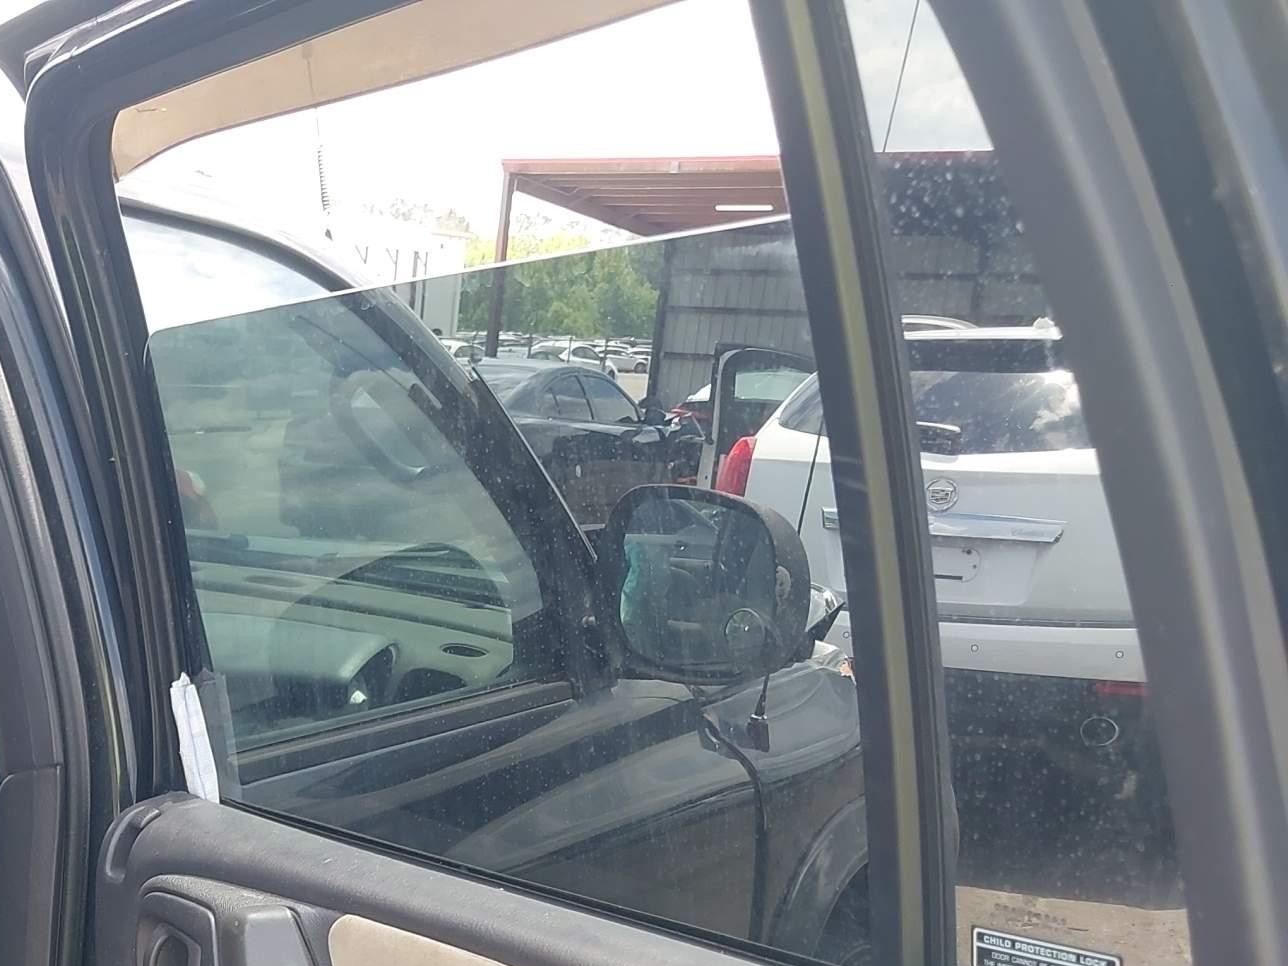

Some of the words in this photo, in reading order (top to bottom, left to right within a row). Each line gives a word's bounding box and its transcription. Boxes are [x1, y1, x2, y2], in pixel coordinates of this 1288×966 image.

[983, 935, 1012, 948] CHILD
[1014, 941, 1078, 963] PROTECTION
[991, 951, 1010, 963] DOOR
